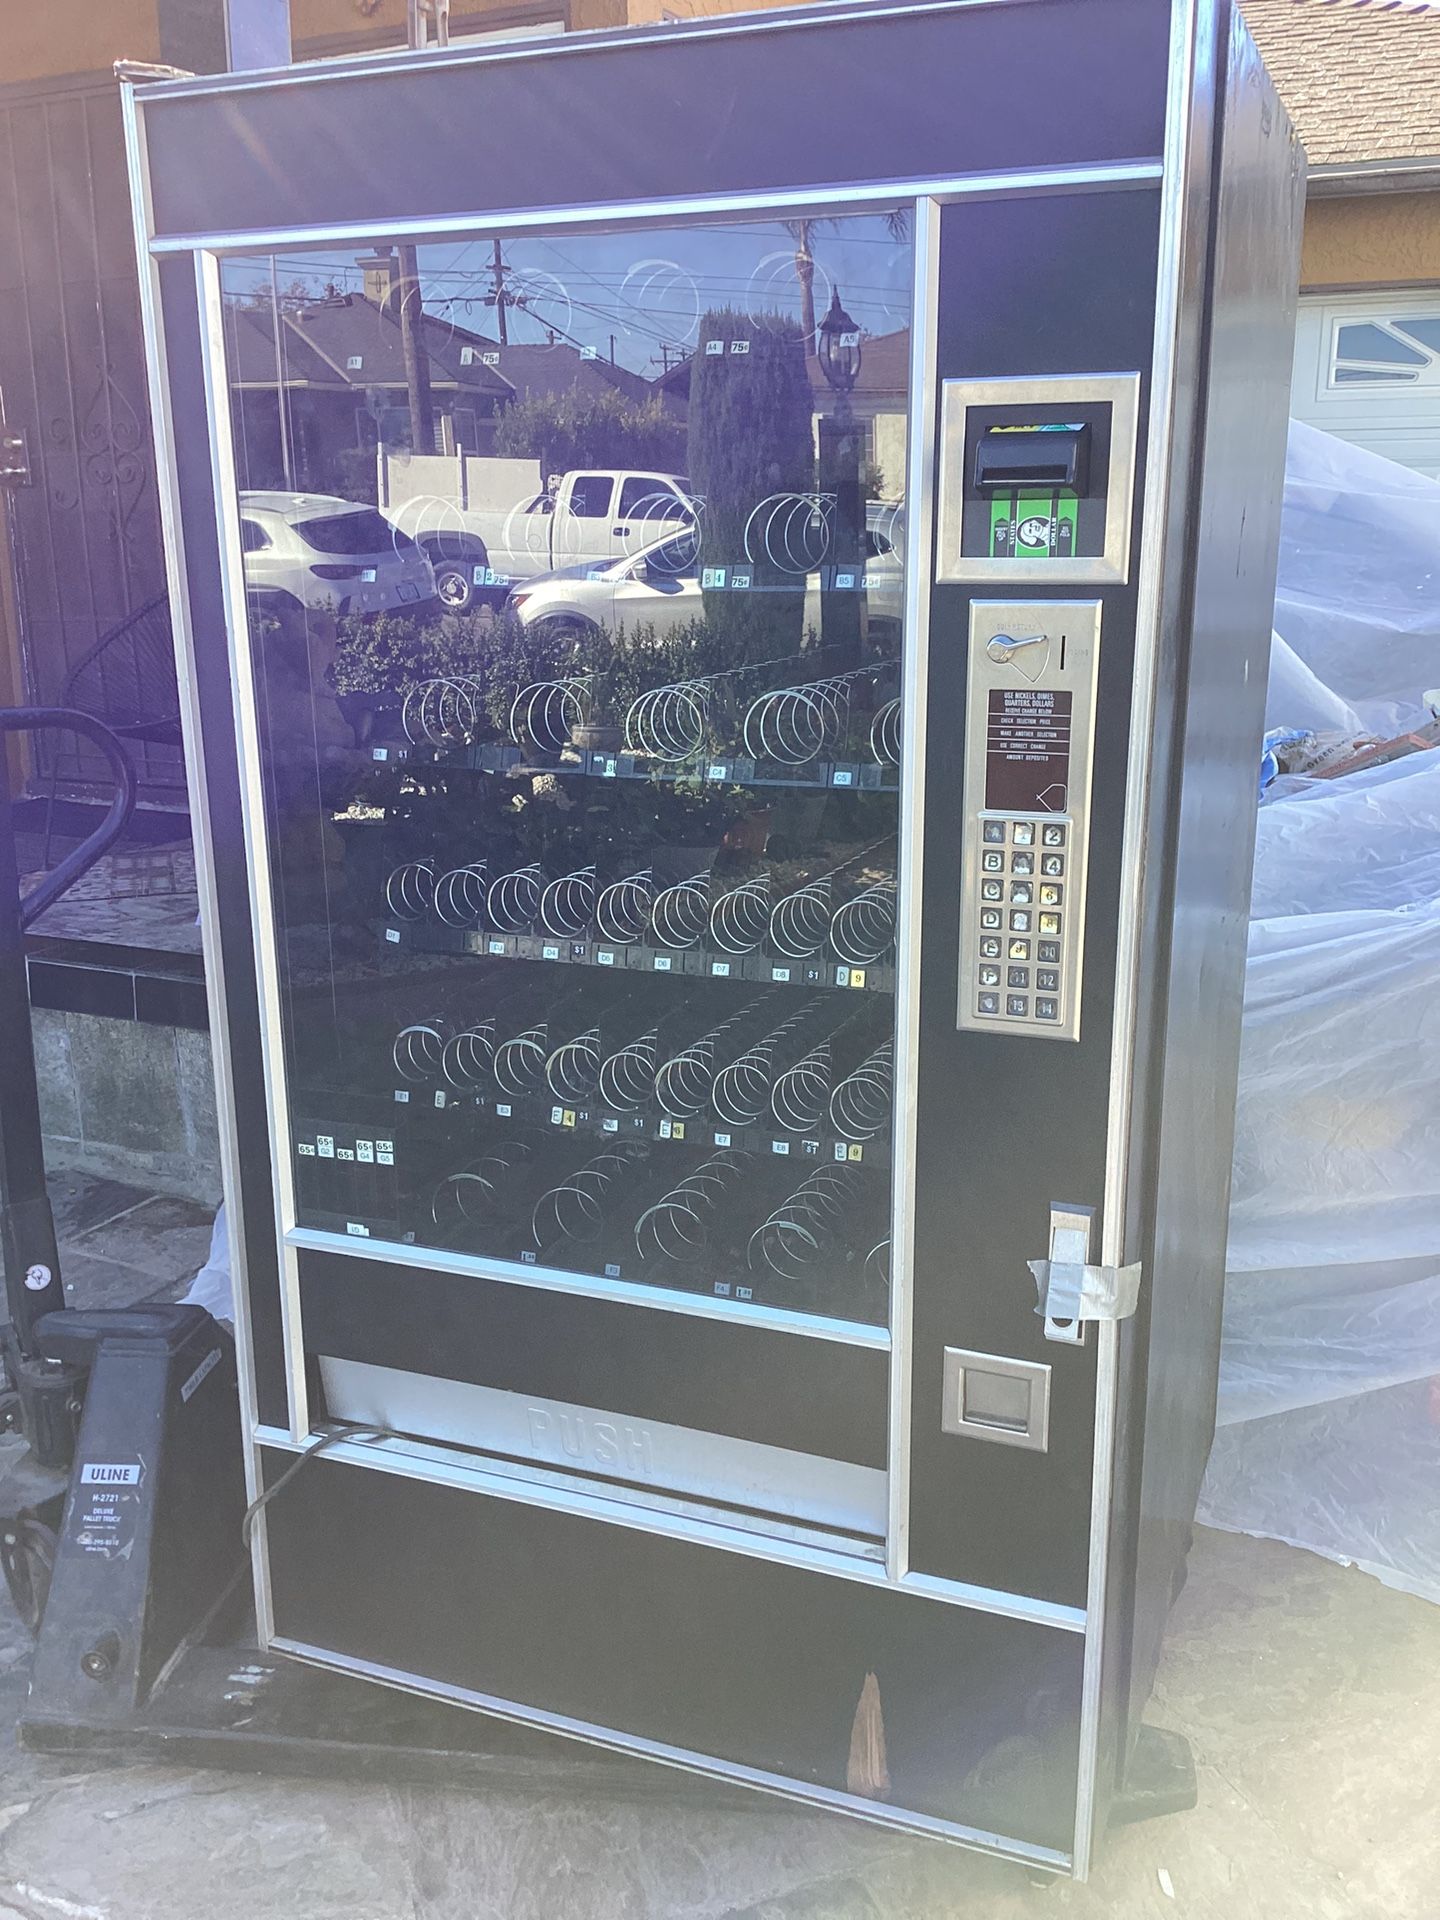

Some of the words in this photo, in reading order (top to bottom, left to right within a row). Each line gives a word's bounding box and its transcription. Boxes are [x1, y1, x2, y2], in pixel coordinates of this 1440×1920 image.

[1032, 700, 1054, 708] DOLLARS
[575, 945, 584, 955] $1
[808, 970, 819, 981] $1
[475, 1096, 484, 1105] $1
[578, 1111, 588, 1120] $1
[634, 1117, 644, 1127] $1
[526, 1407, 653, 1475] PUSH
[91, 1468, 130, 1481] ULINE
[92, 1494, 119, 1502] H-2721
[93, 1507, 114, 1515] DELUXE
